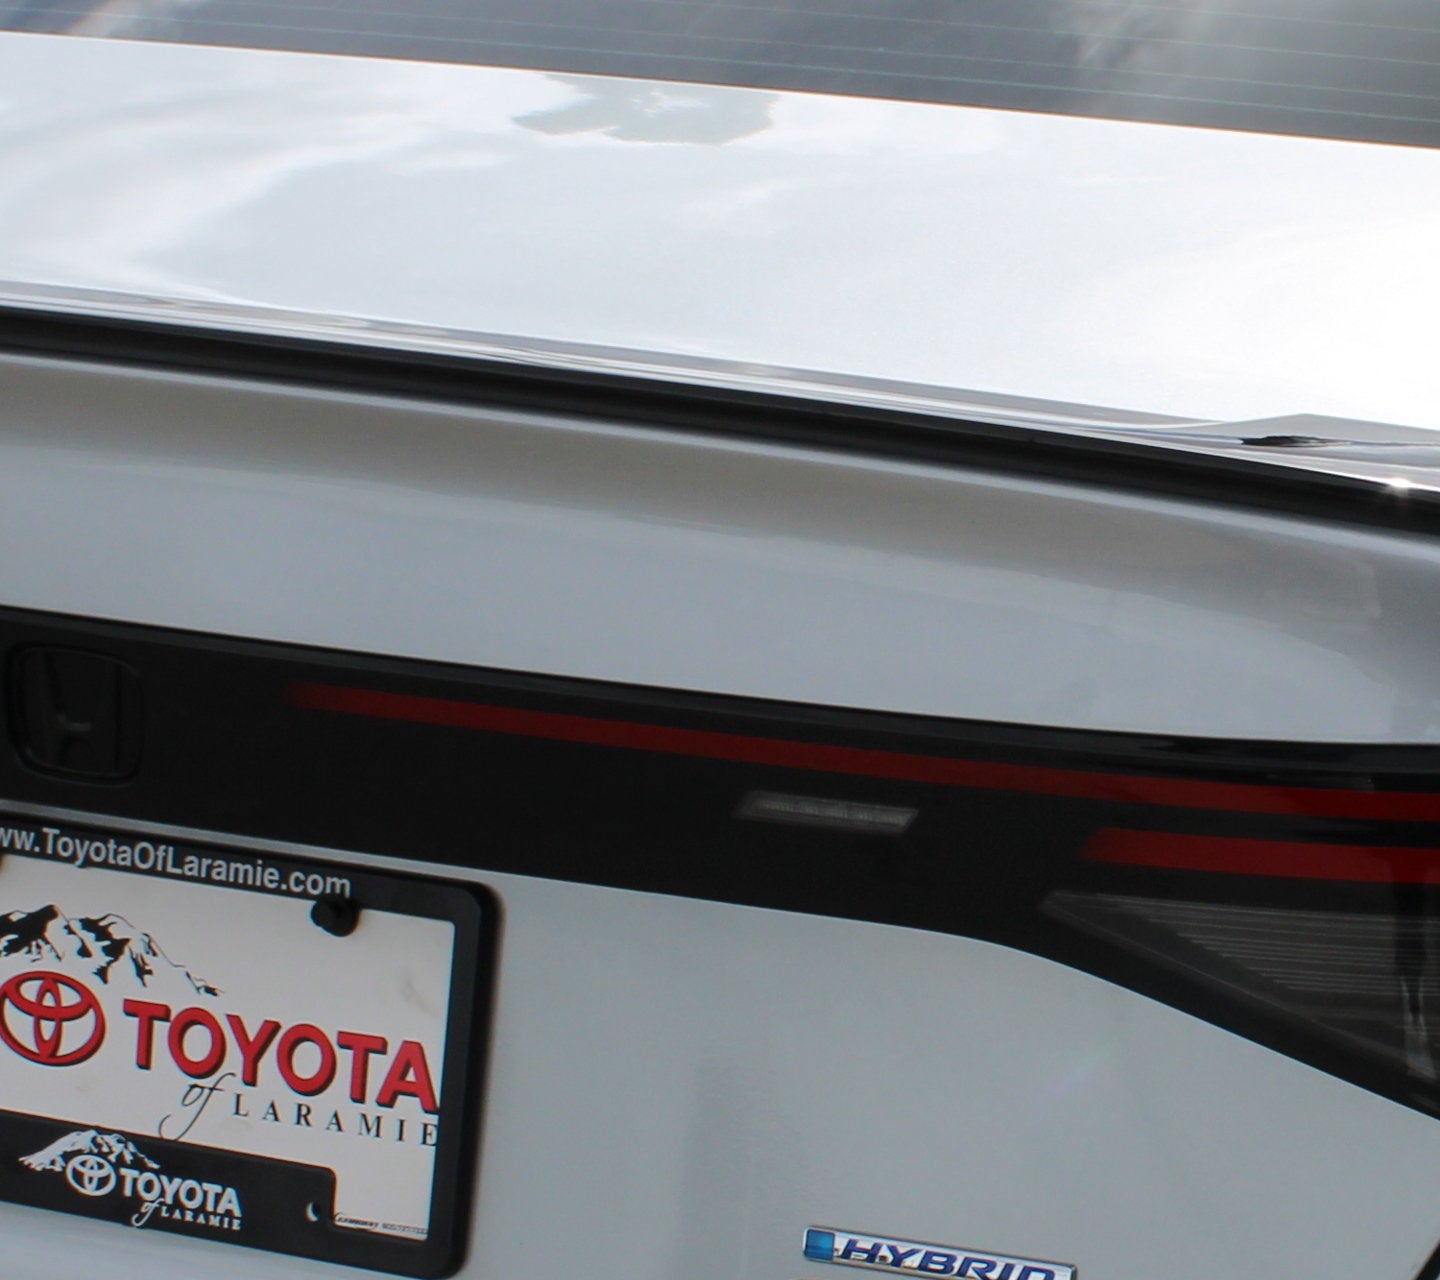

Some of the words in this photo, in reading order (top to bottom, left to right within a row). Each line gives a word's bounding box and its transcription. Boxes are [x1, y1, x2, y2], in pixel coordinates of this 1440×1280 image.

[122, 997, 440, 1115] TOYOTA
[159, 1072, 237, 1142] of
[233, 1092, 439, 1147] LARAMIE
[119, 1167, 243, 1218] TOYOTA
[131, 1197, 164, 1227] of
[160, 1205, 242, 1231] LARAMIE
